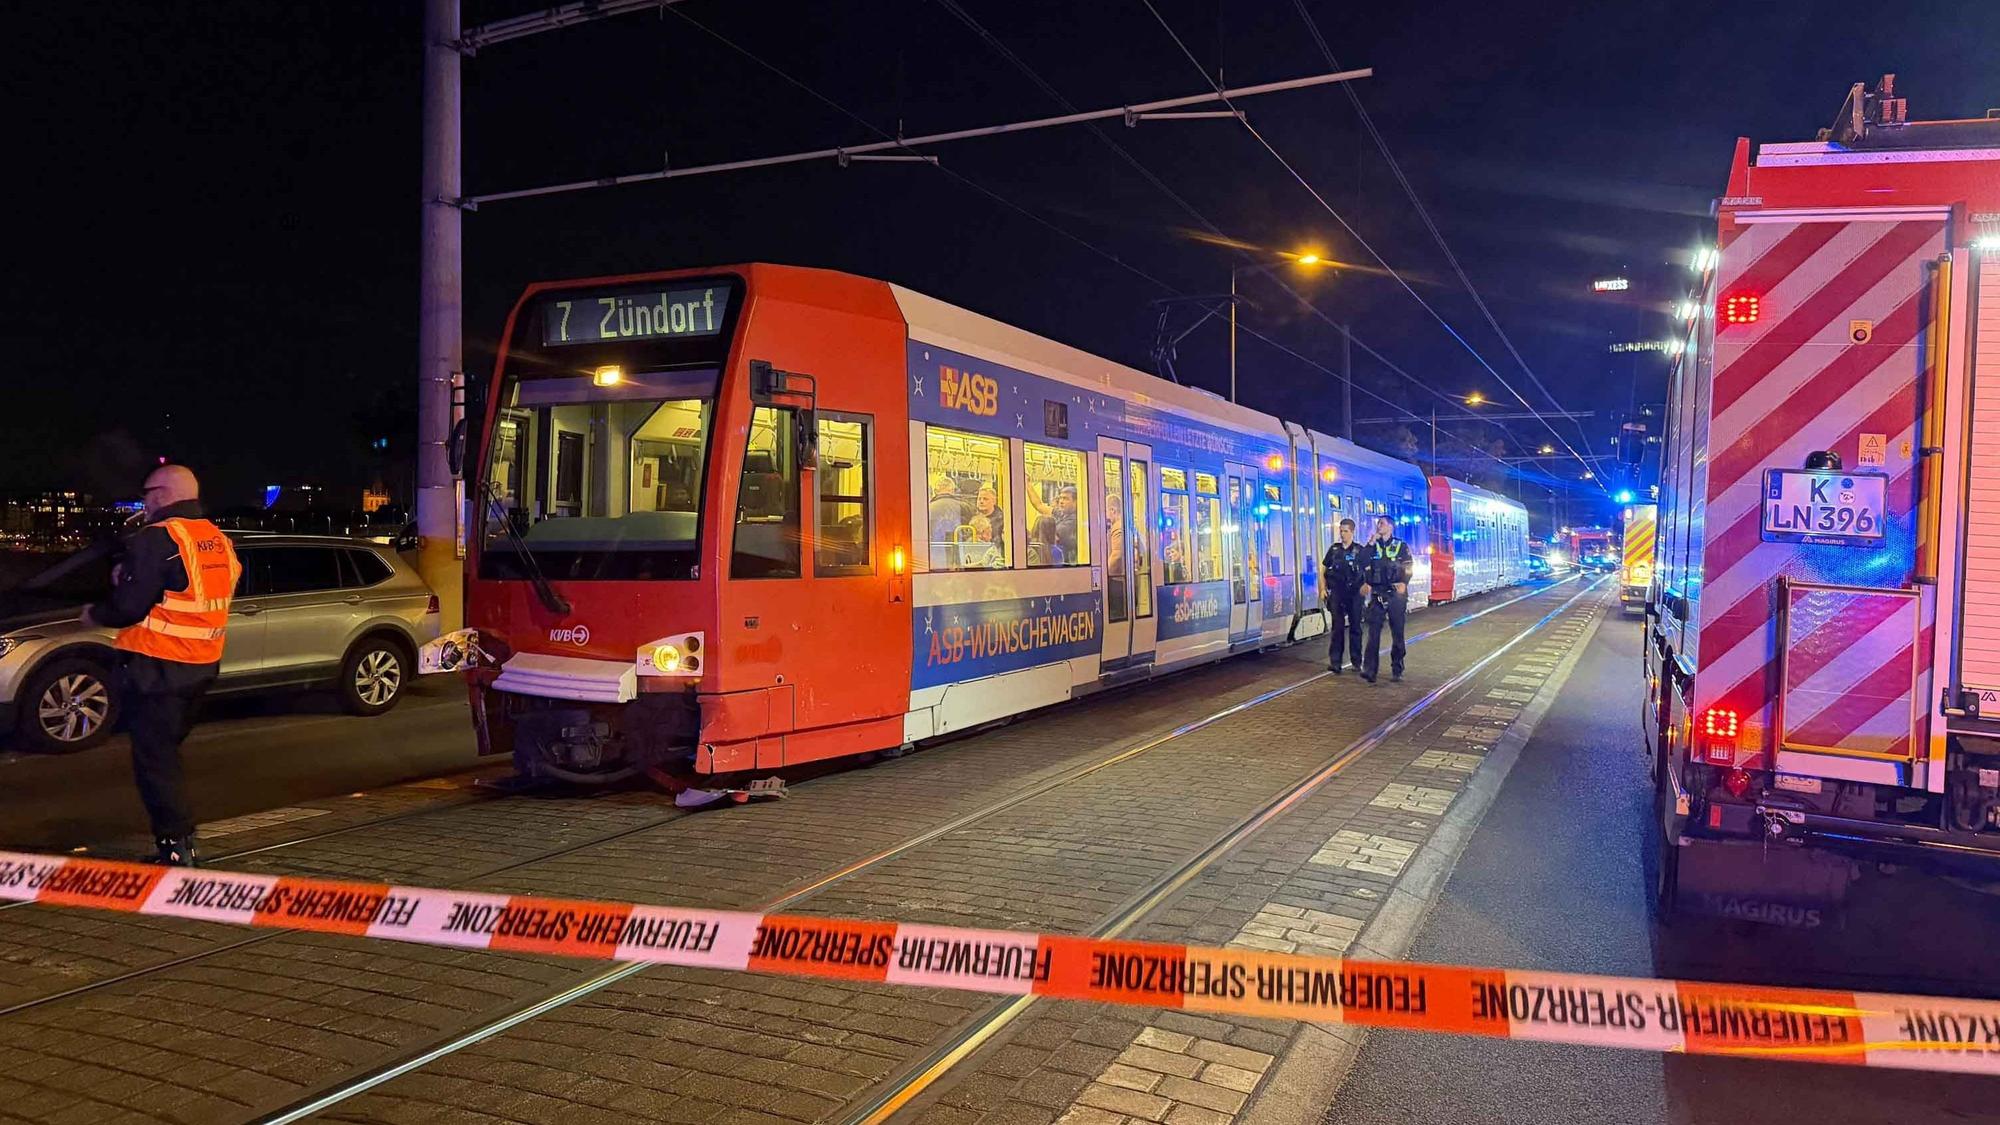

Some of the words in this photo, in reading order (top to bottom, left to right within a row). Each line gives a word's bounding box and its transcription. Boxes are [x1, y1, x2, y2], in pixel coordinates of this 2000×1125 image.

[557, 302, 571, 341] 7
[599, 289, 714, 338] Zündorf
[955, 371, 999, 417] ASB
[1771, 489, 1778, 497] D
[1810, 478, 1829, 503] K
[1773, 504, 1811, 530] LN
[1818, 506, 1873, 533] 396
[197, 540, 214, 552] KVB
[1814, 538, 1845, 546] MAGIRUS
[1174, 593, 1218, 623] asb-nrw.de
[550, 628, 571, 642] KVB
[927, 611, 1094, 667] ASB-WÜNSCHEWAGEN
[166, 876, 420, 926] FEUERWEHR-SPERRZONE
[1703, 893, 1820, 926] MAGIRUS
[442, 901, 719, 953] FEUERWEHR-SPERRZONE
[749, 925, 1051, 982] FEUERWEHR-SPERRZONE
[1090, 951, 1427, 1015] FEUERWEHR-SPERRZONE
[1471, 981, 1850, 1044] FEUERWEHR-SPERRZONE
